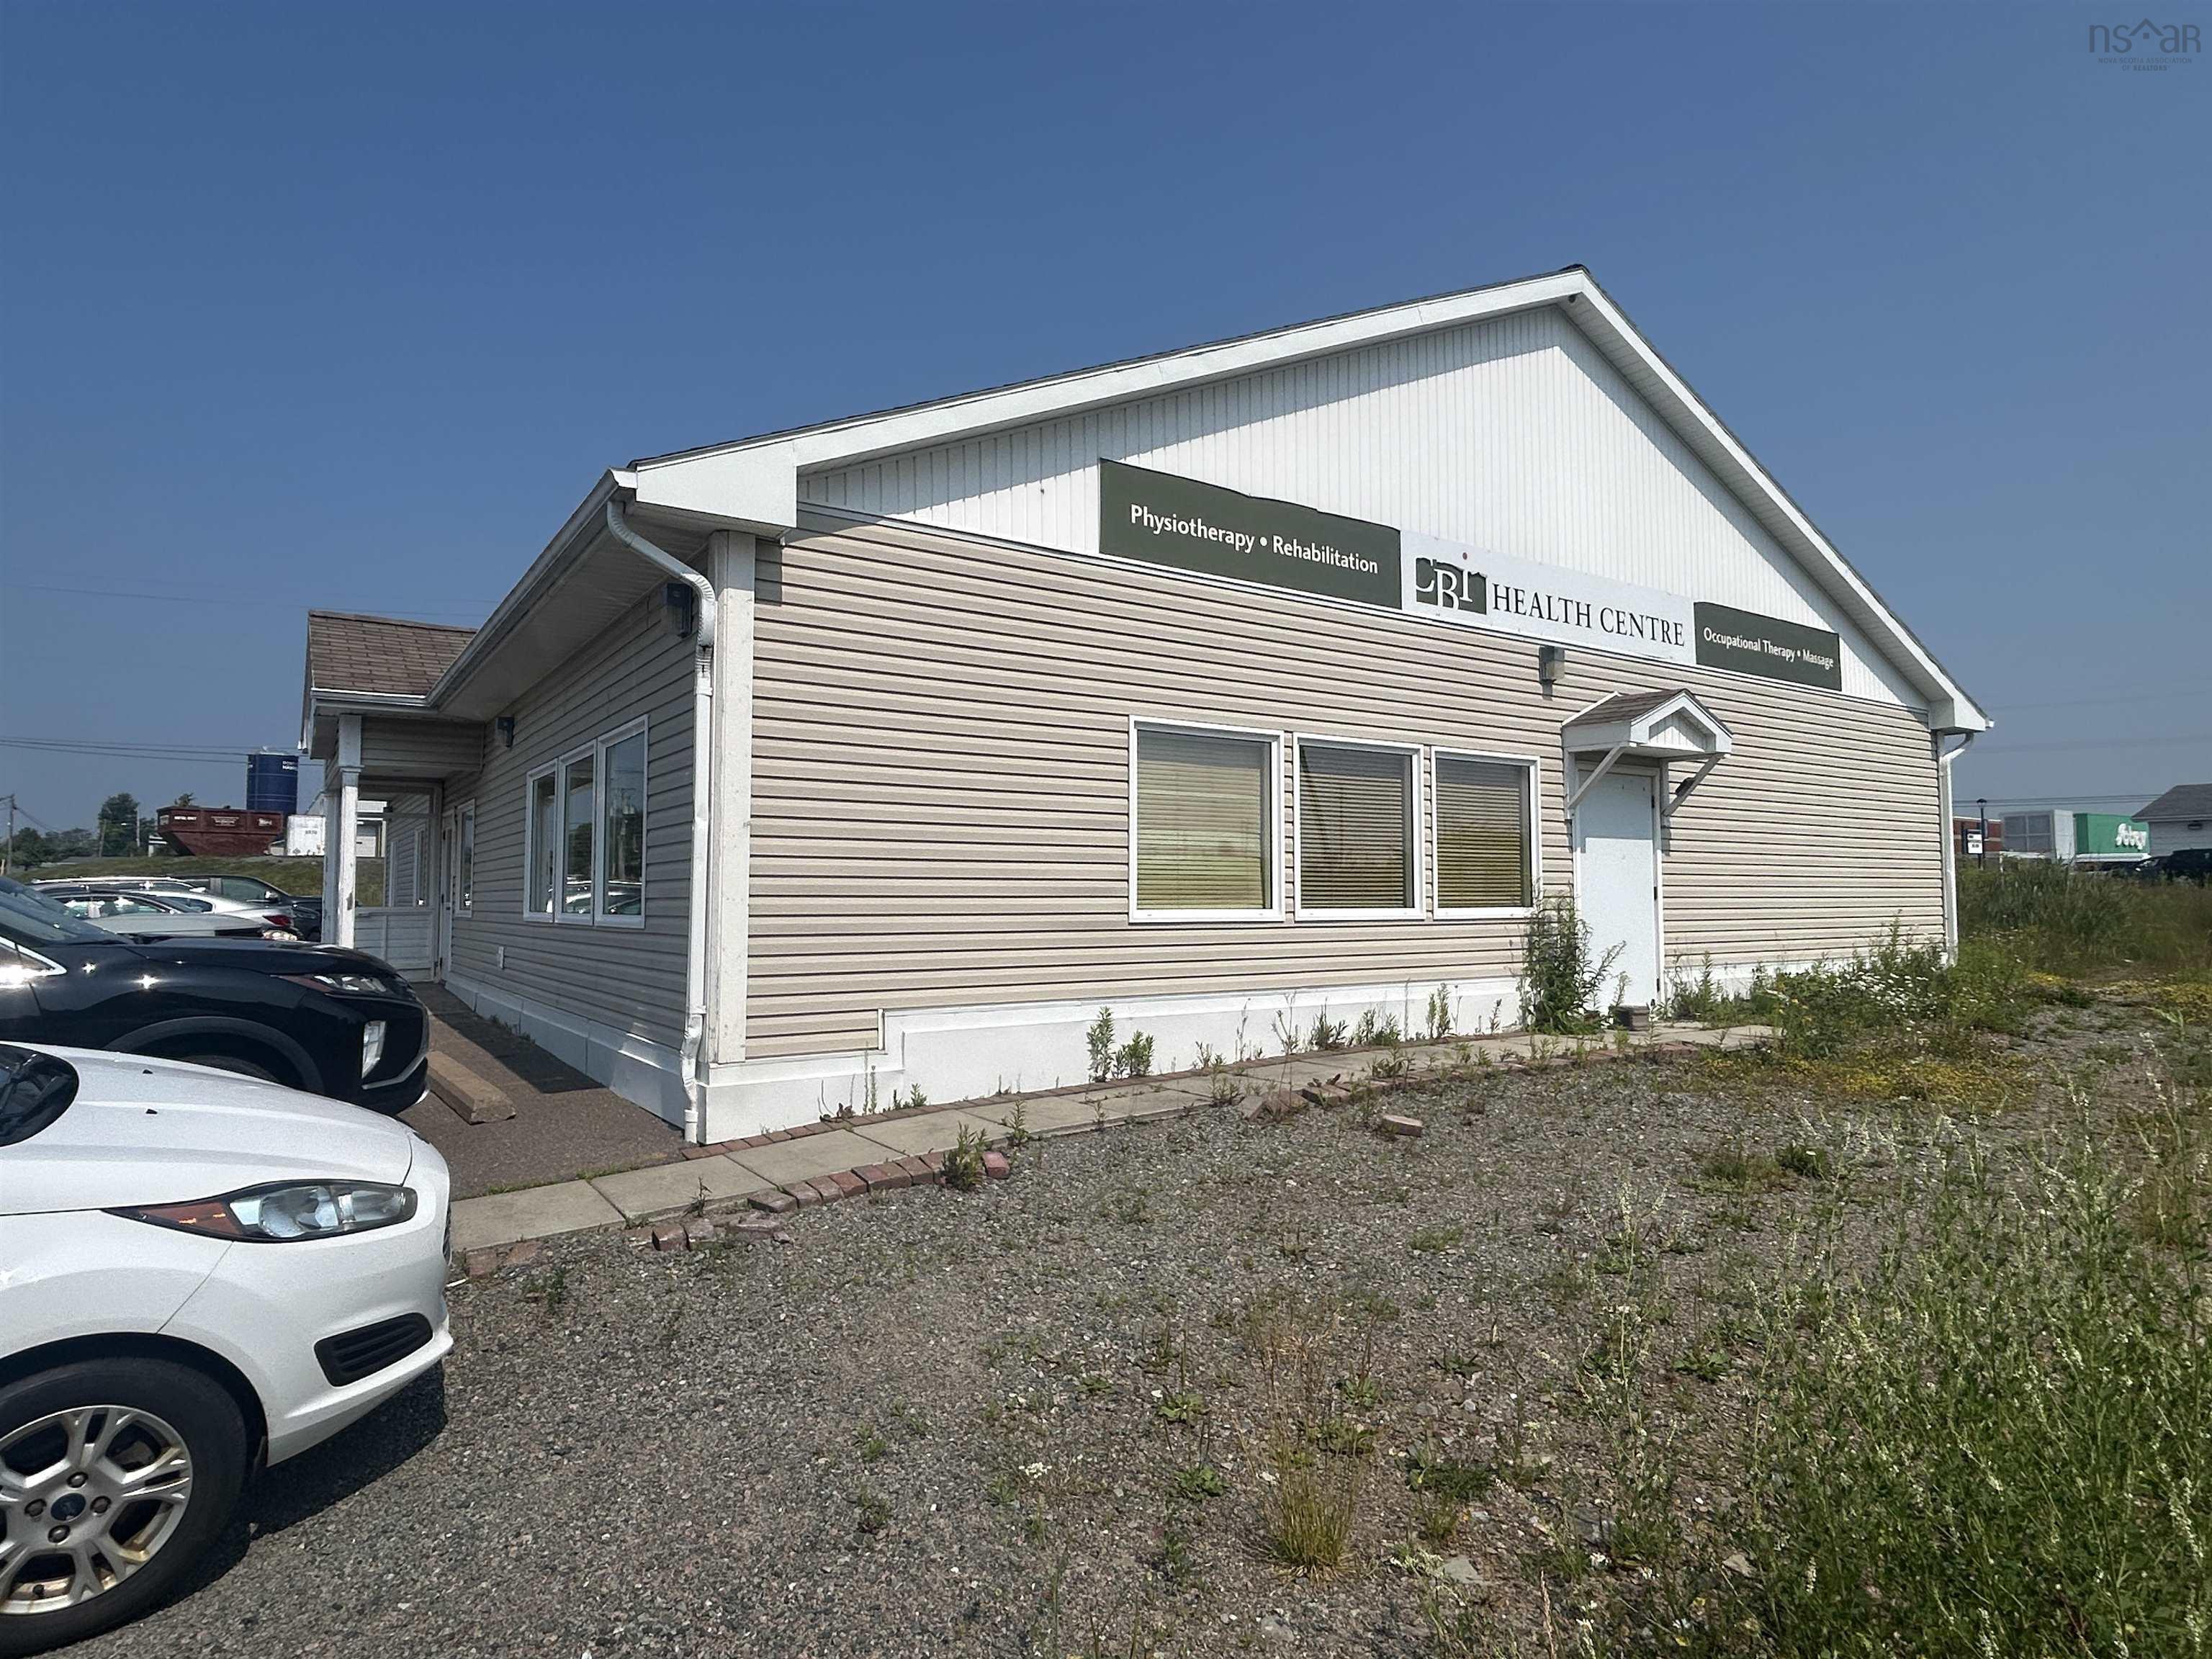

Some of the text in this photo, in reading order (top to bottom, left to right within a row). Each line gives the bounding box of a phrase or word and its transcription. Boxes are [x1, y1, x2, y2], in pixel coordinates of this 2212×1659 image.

[1130, 505, 1378, 574] Physiotherapy Rehabilitation
[1492, 583, 1592, 629] HEALTH
[1599, 607, 1686, 647] CENTRE
[1703, 626, 1835, 671] Occupational Therapy Massage
